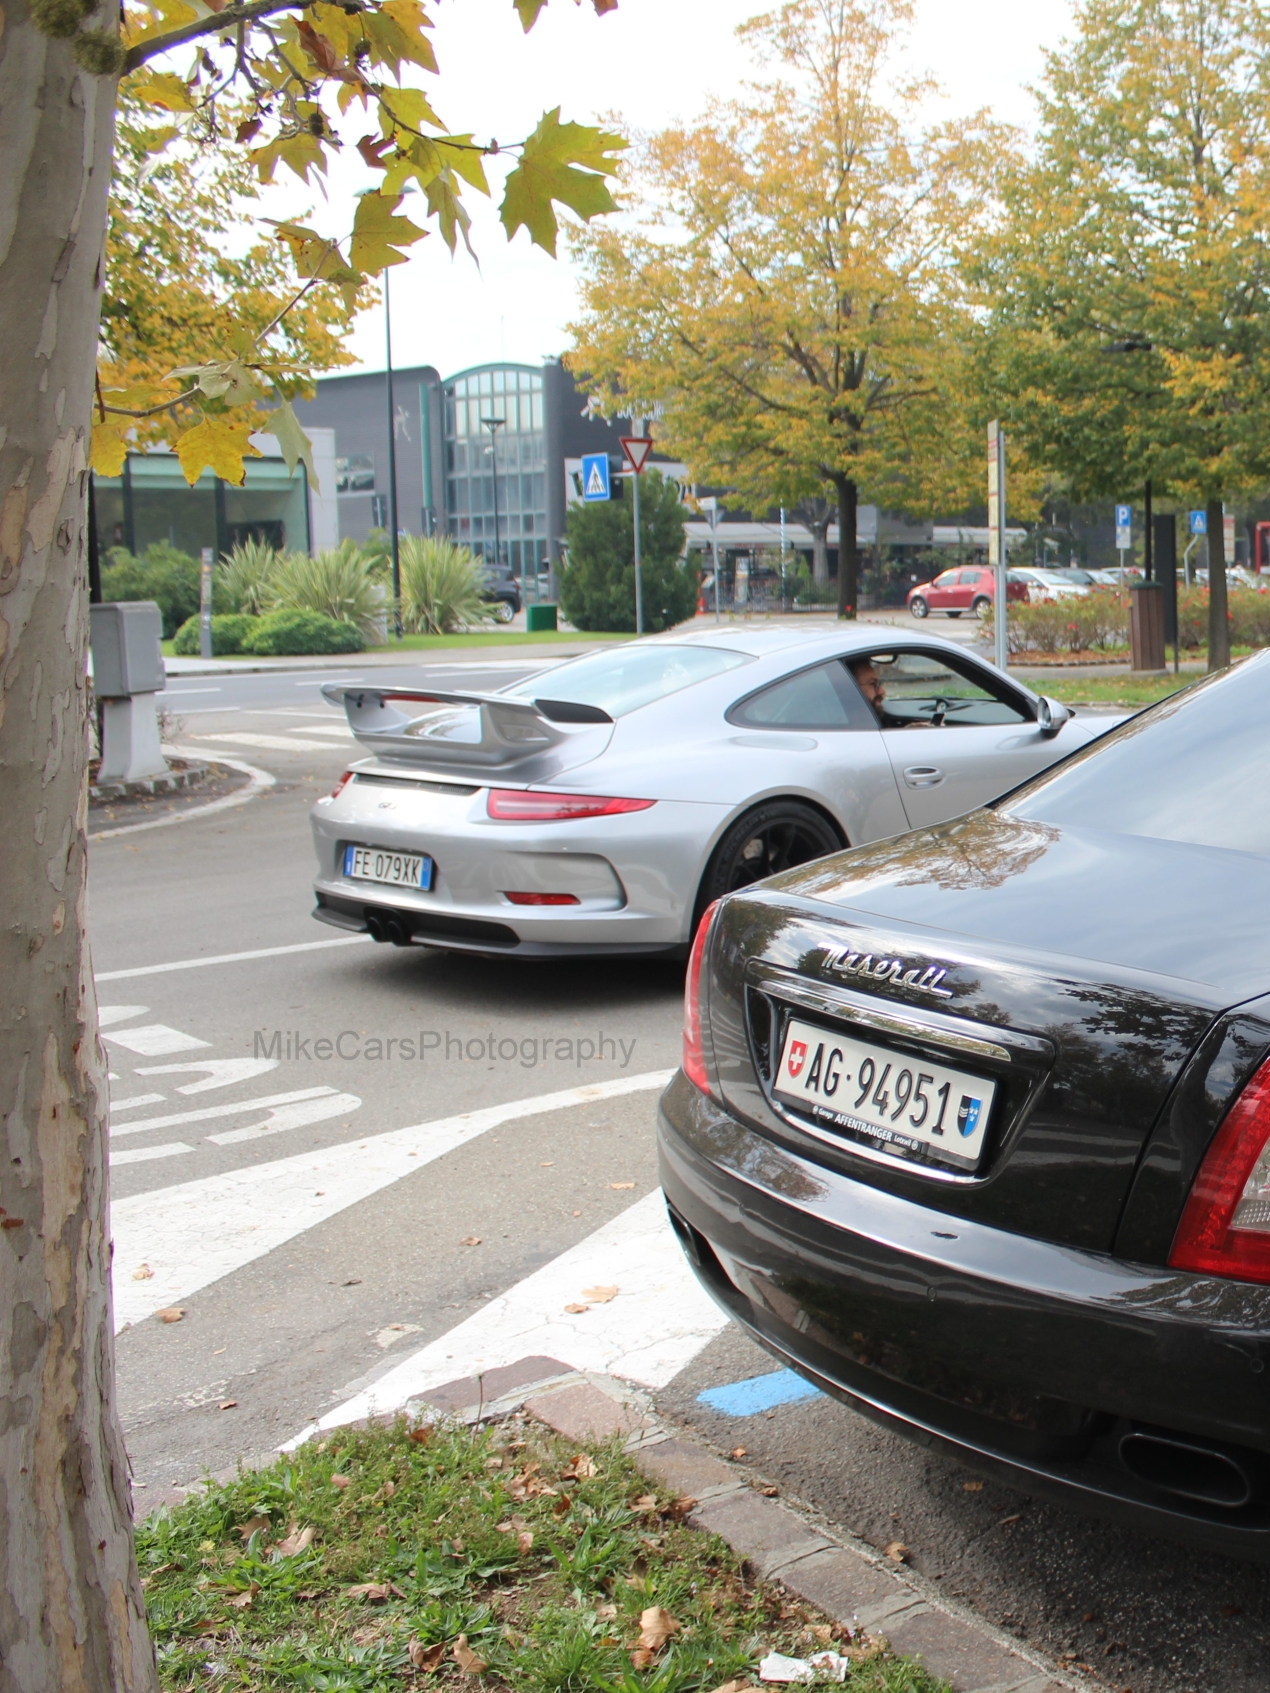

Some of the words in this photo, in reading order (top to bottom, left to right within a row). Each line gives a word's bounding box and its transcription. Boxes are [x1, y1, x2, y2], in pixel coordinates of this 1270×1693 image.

[1118, 507, 1128, 525] P
[354, 850, 371, 876] FE
[375, 854, 421, 885] 079XK
[817, 942, 954, 999] Maserati
[819, 1107, 834, 1120] Garage
[834, 1113, 893, 1142] AFFENTRANGER
